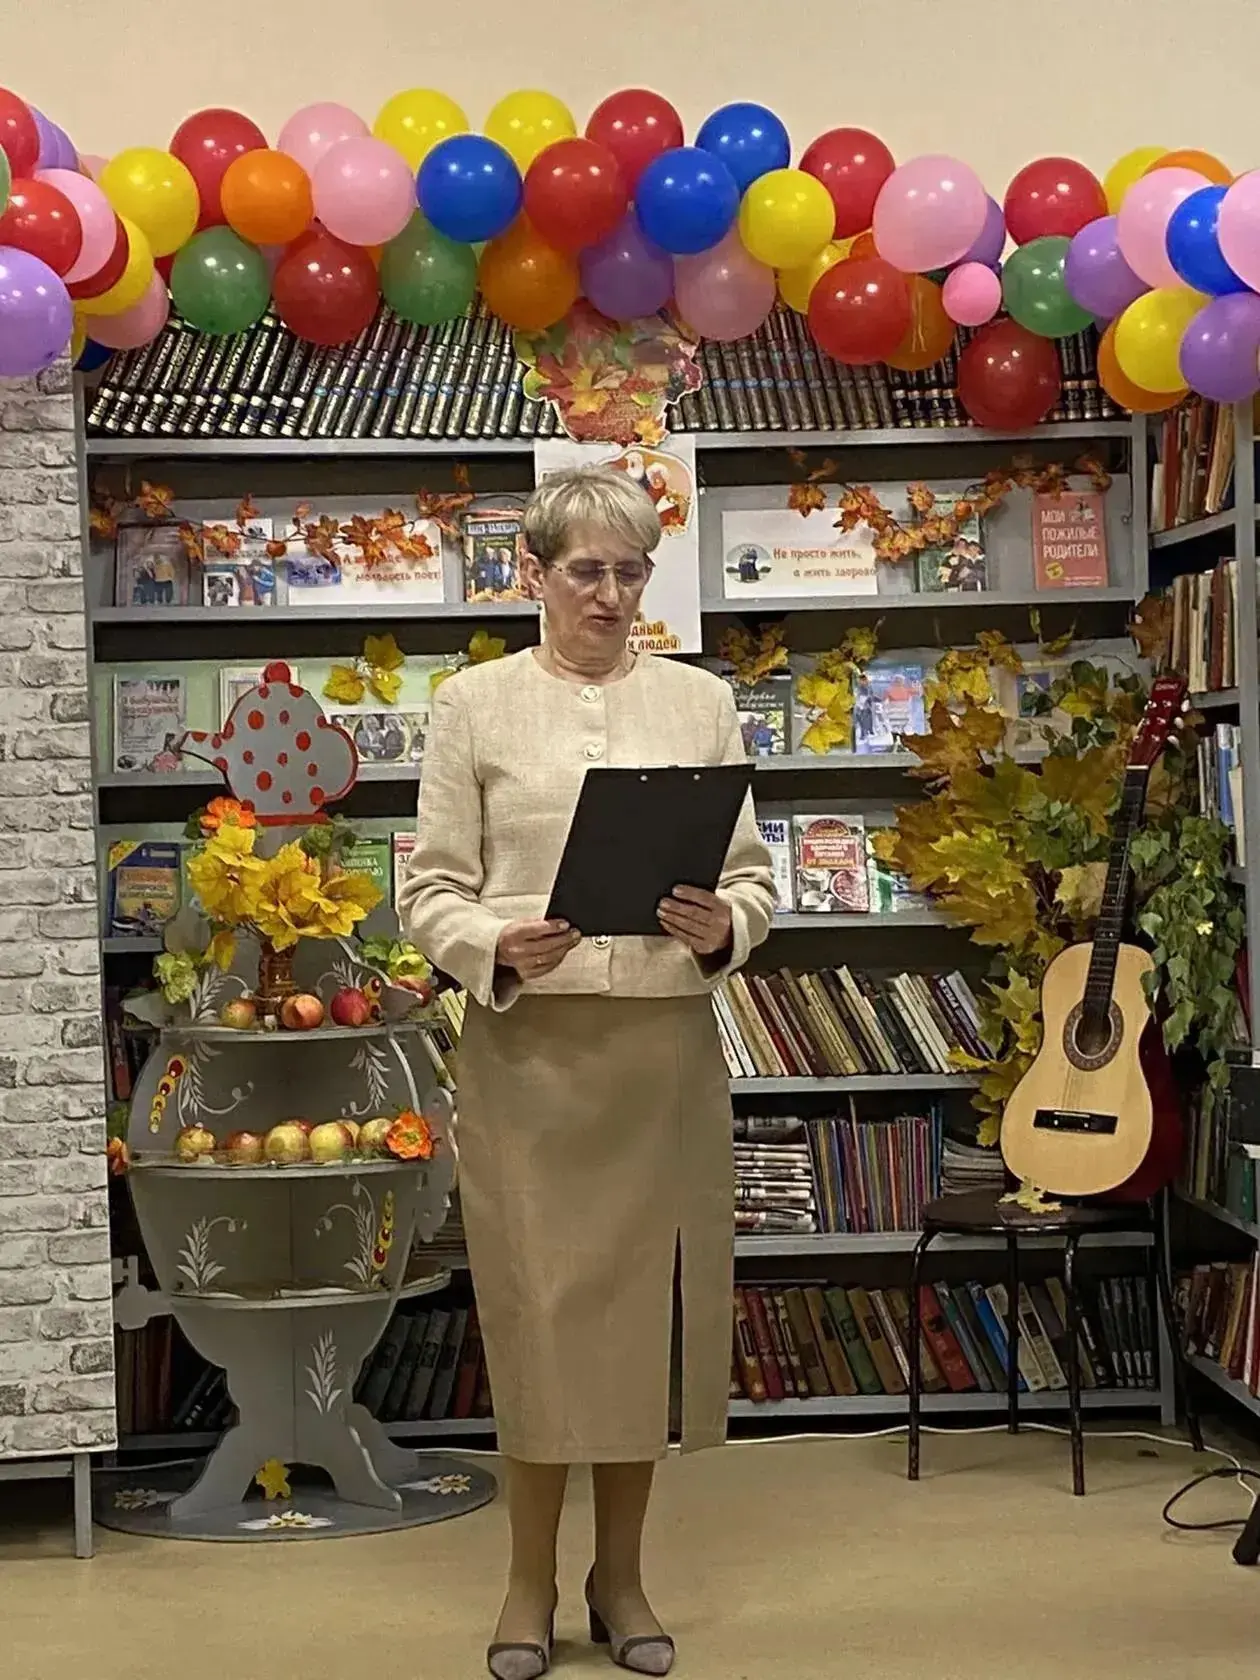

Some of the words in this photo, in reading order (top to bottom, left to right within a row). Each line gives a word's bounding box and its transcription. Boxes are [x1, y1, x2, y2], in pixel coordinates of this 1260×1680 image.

[1042, 527, 1098, 541] ПОЖИЛЫЕ
[773, 548, 788, 559] Не
[790, 549, 827, 562] просто
[1043, 544, 1099, 559] РОДИТЕЛИ
[804, 568, 832, 578] жить
[638, 634, 679, 650] людей
